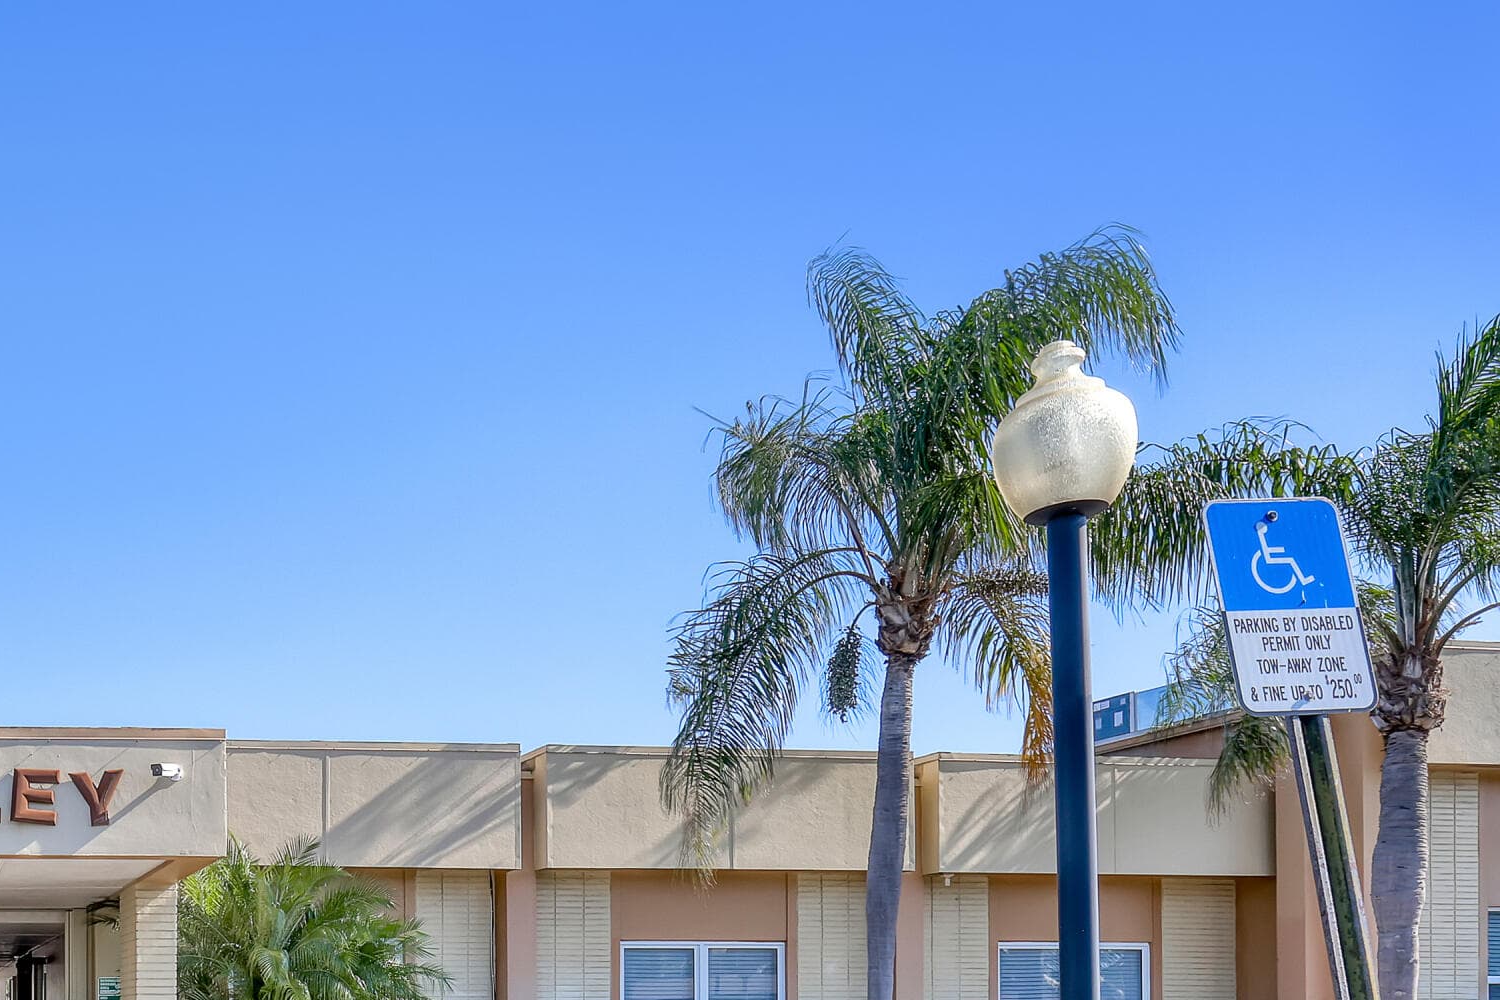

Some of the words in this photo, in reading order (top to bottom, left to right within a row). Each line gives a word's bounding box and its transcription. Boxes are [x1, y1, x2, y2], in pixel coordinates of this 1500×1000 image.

[1233, 617, 1279, 634] PARKING
[1283, 616, 1296, 632] BY
[1300, 615, 1354, 632] DISABLED
[1261, 635, 1301, 652] PERMIT
[1305, 635, 1331, 650] ONLY
[1256, 658, 1312, 674] TOW-AWAY
[1317, 656, 1348, 672] ZONE
[1251, 686, 1259, 702] &
[1262, 686, 1288, 701] FINE
[1290, 685, 1306, 701] UP
[1308, 684, 1324, 700] TO
